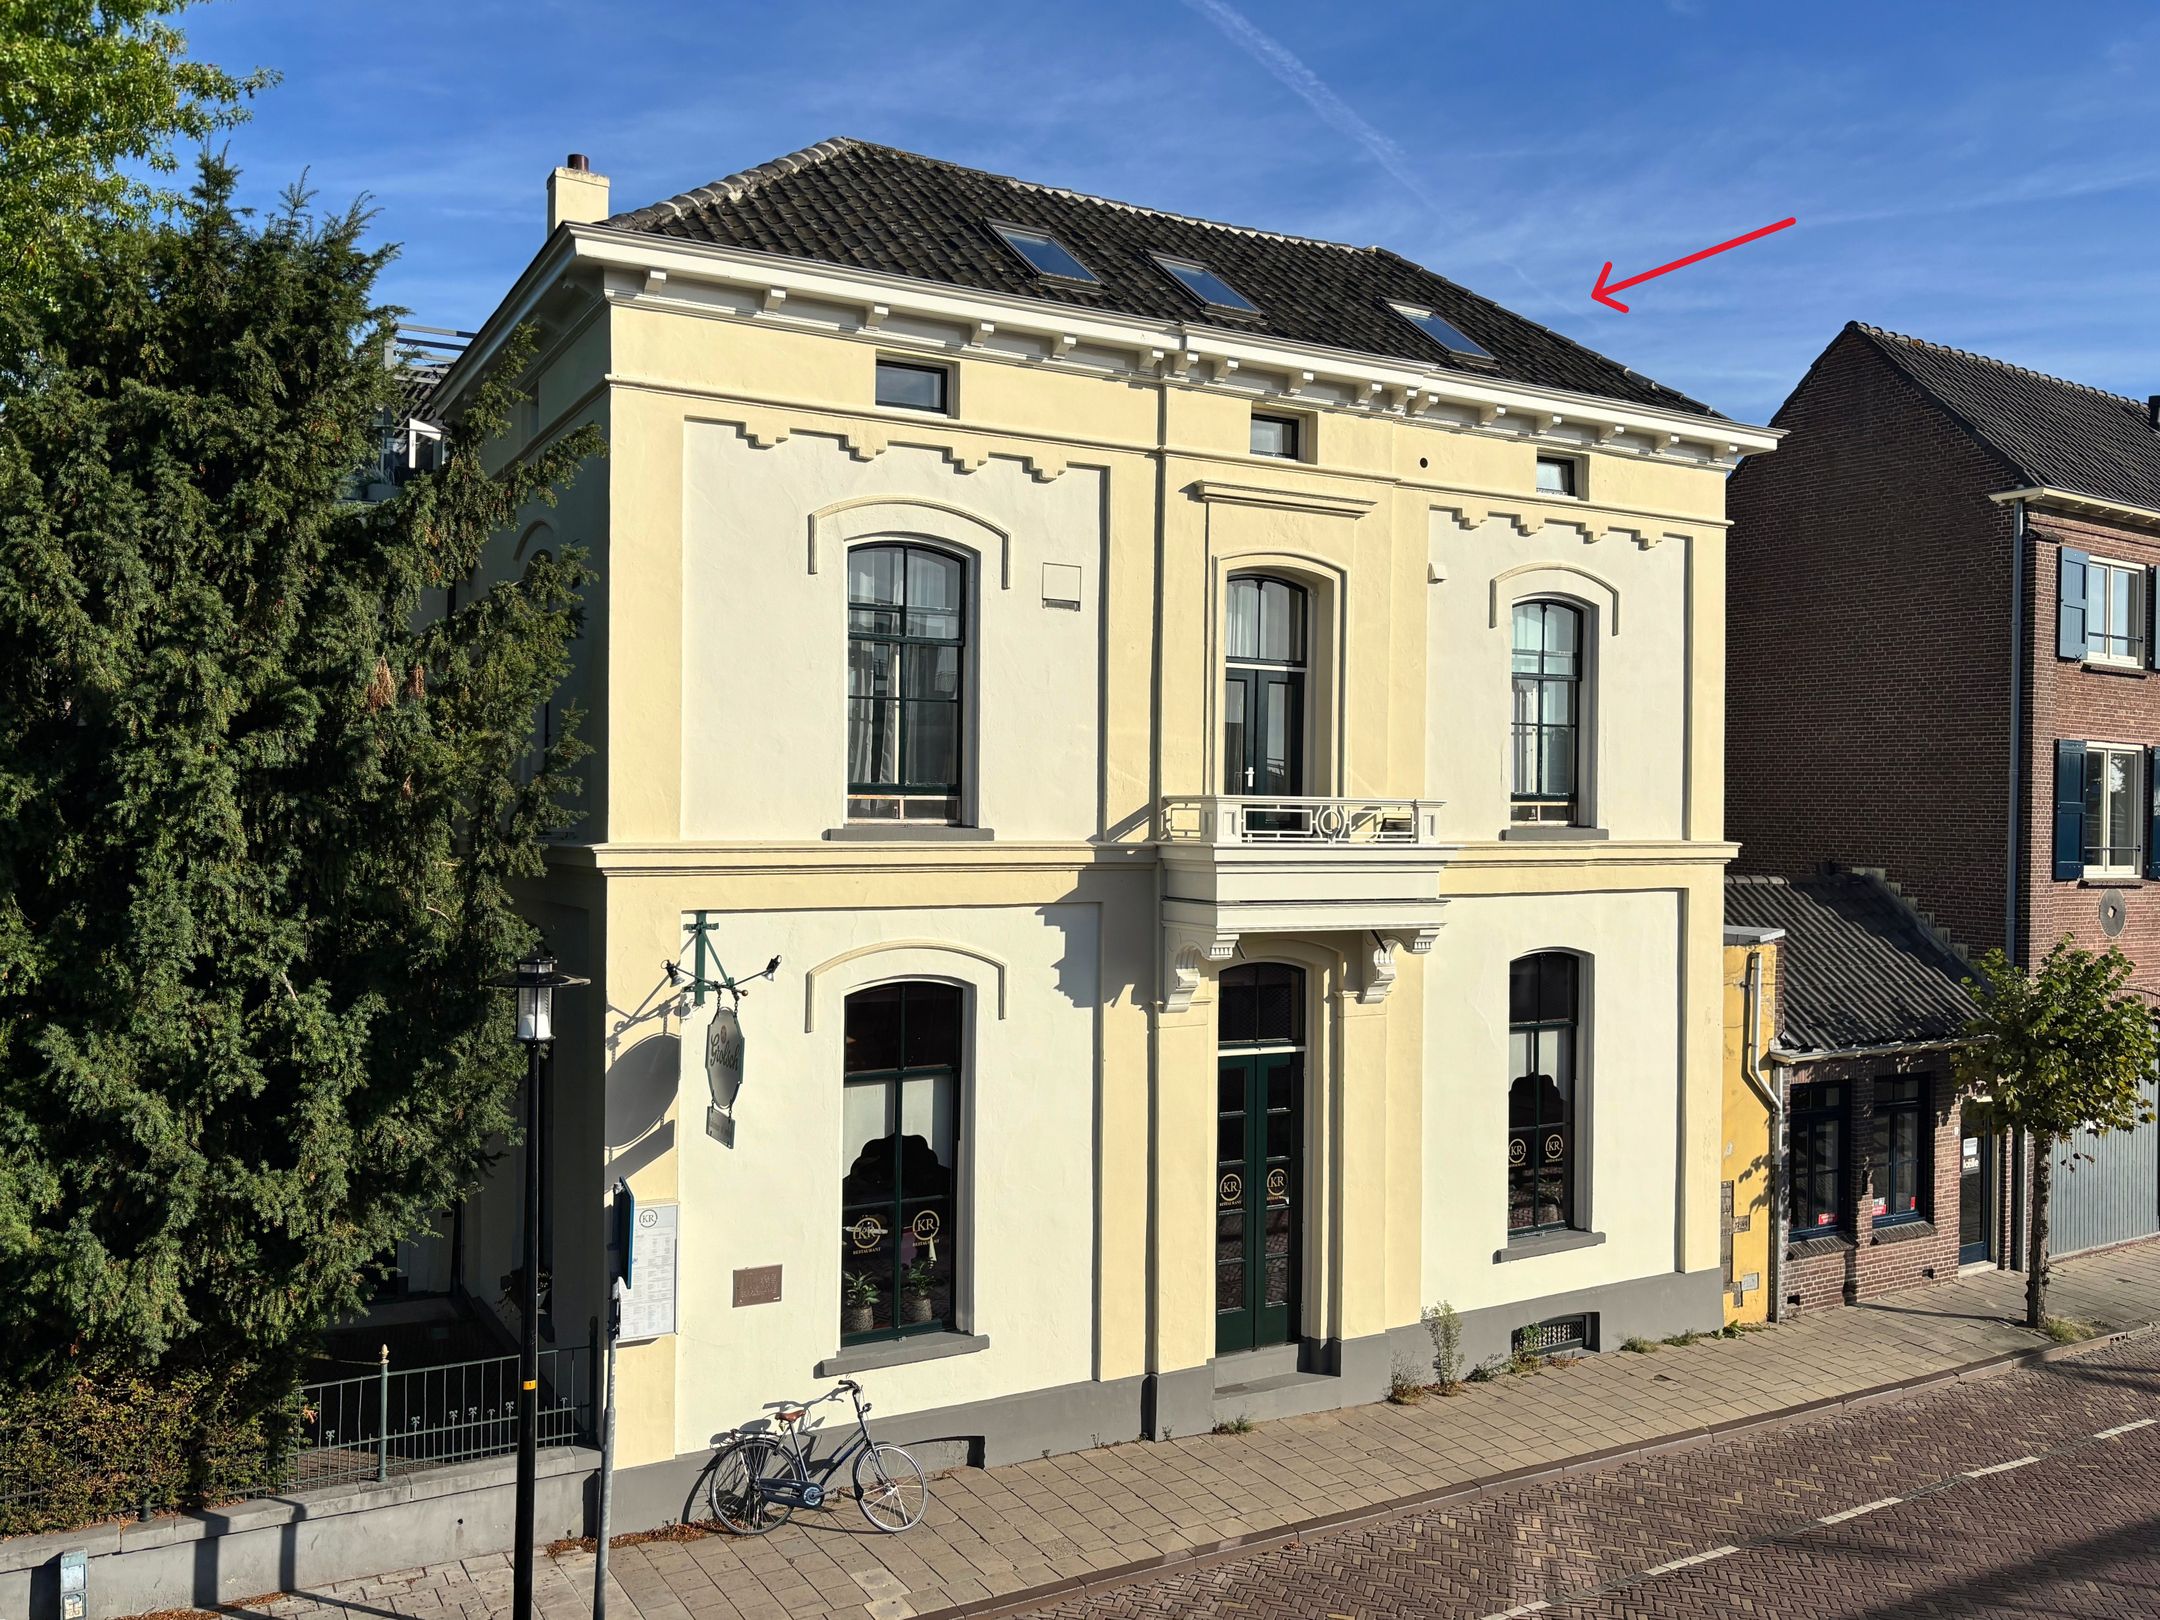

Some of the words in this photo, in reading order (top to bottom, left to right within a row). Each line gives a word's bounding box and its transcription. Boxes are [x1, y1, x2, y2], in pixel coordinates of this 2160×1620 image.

[710, 1033, 740, 1071] Grolsch
[1510, 1145, 1523, 1156] KR
[1548, 1140, 1560, 1151] KR
[1223, 1181, 1238, 1193] KR
[1270, 1176, 1285, 1188] KR
[642, 1214, 654, 1224] KR
[917, 1218, 936, 1232] KR
